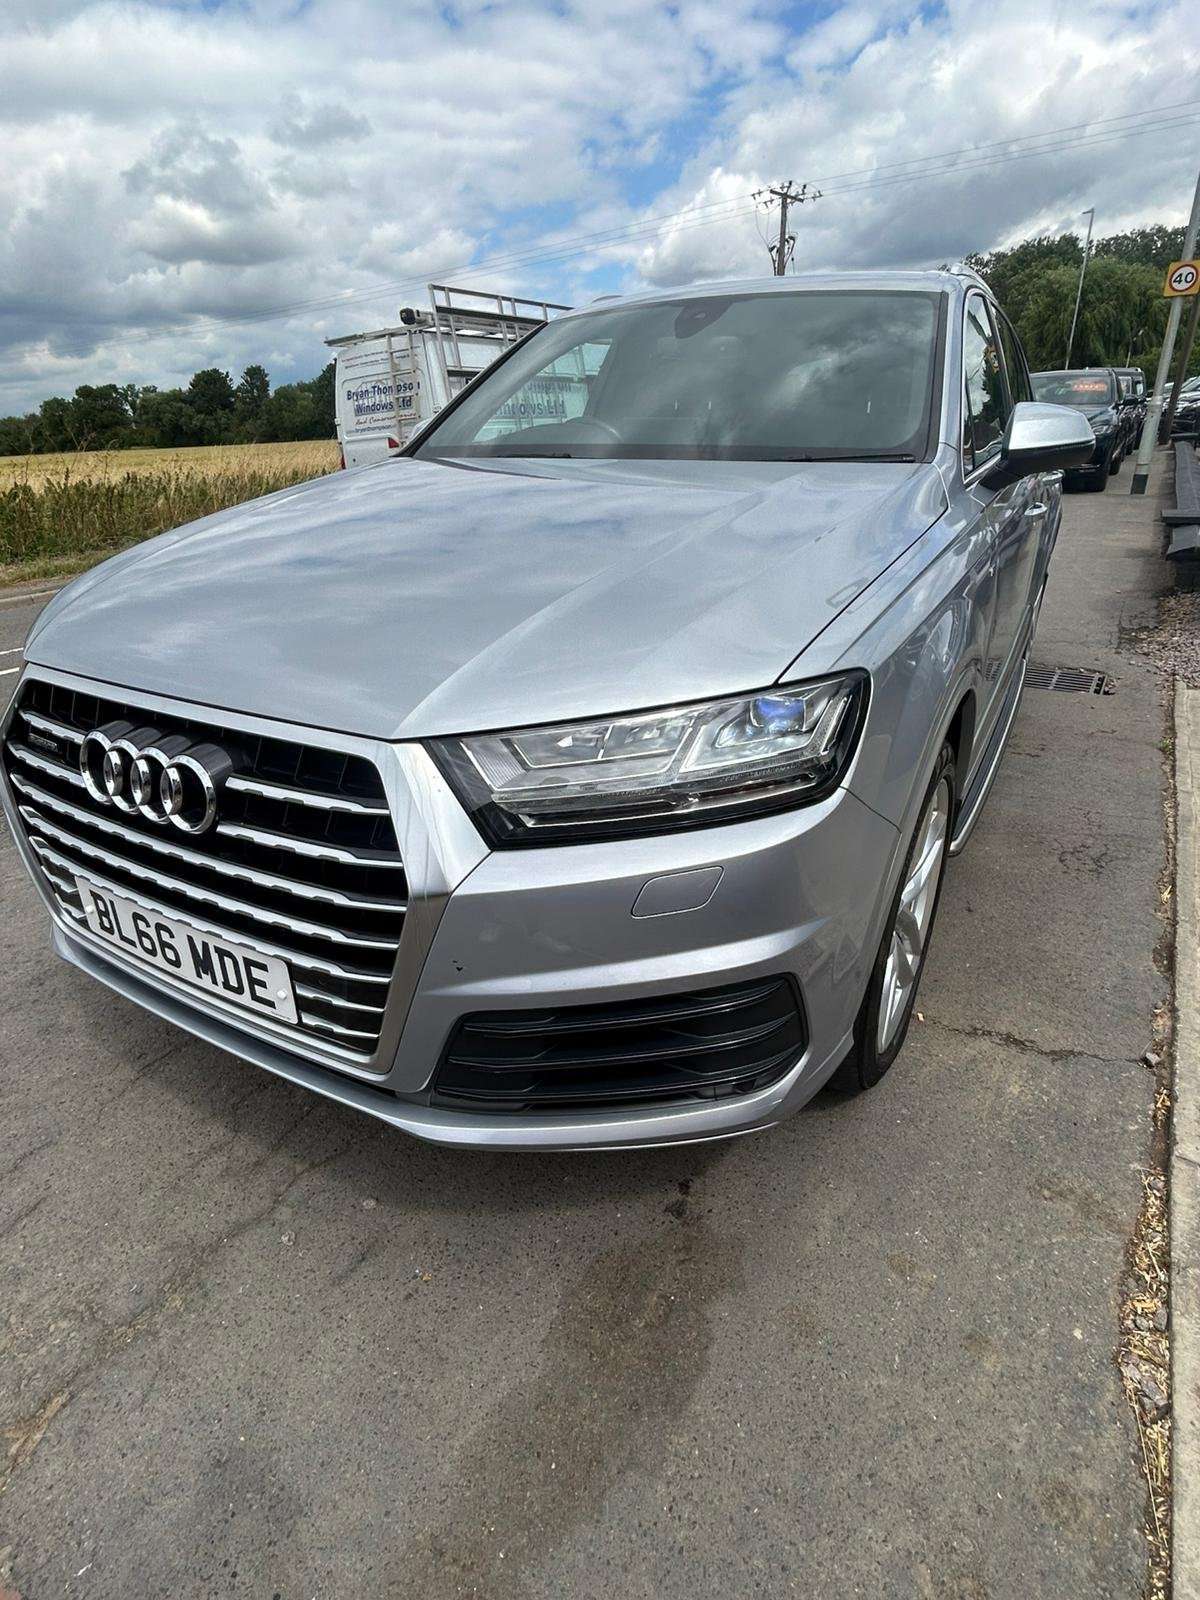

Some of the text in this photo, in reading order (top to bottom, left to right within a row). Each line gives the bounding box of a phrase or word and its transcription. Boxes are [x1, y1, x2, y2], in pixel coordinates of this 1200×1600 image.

[1173, 272, 1195, 285] 40
[347, 388, 369, 402] Bryan
[354, 401, 394, 414] Windows
[89, 889, 276, 1010] BL66 MDE
